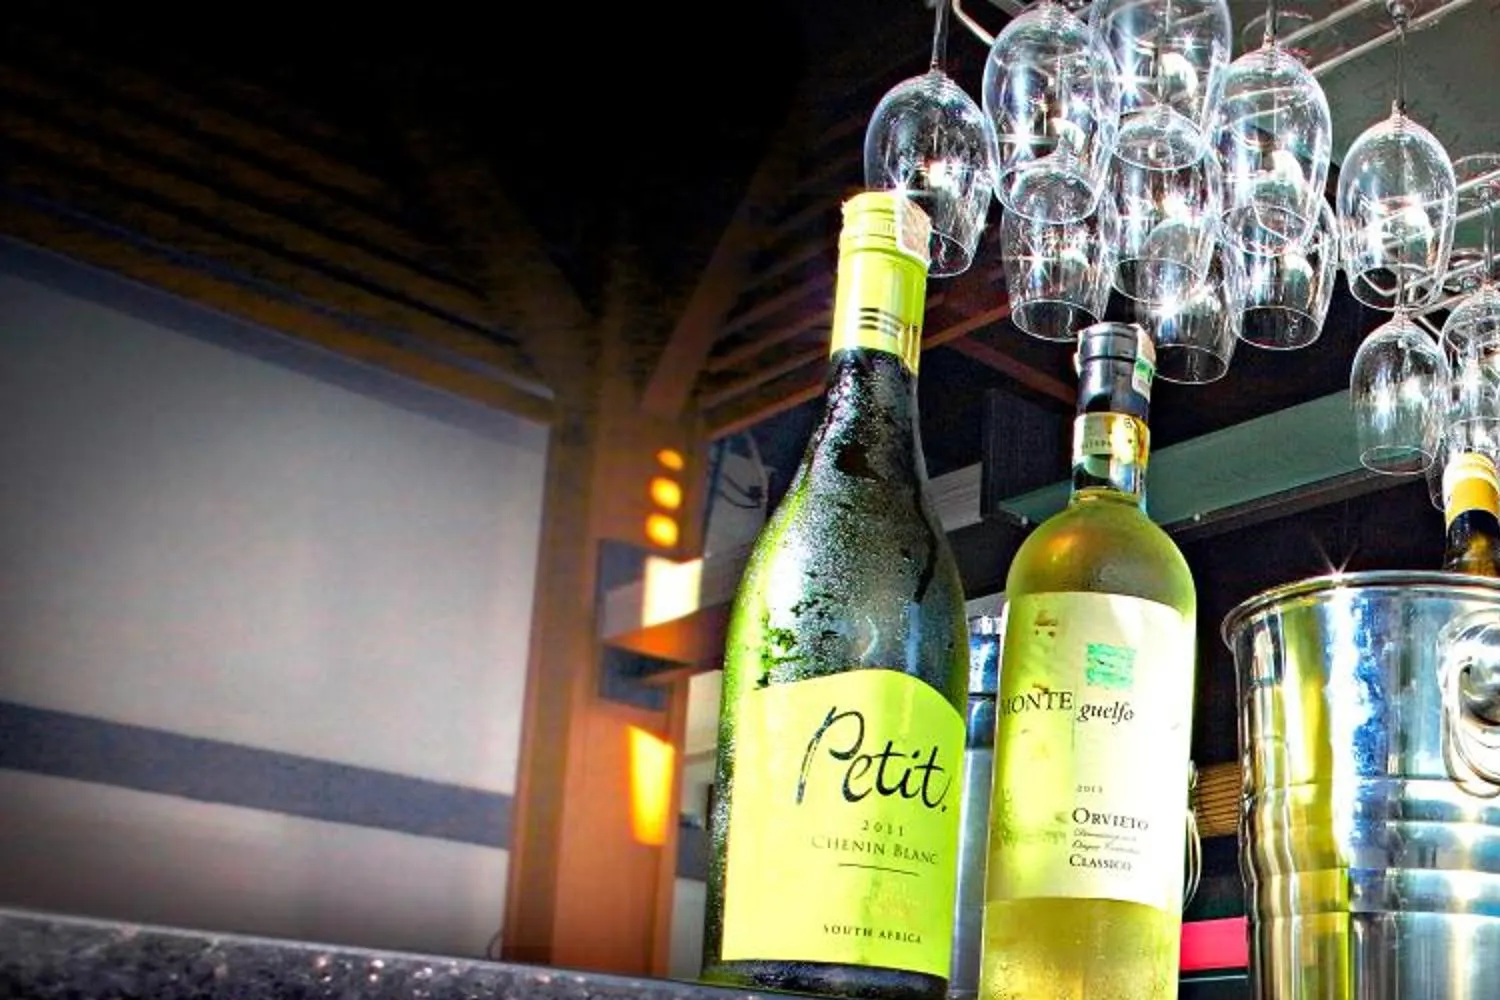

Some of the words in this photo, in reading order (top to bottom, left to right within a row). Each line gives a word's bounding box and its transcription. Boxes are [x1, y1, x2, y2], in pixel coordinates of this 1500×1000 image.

[862, 819, 904, 837] 2011
[811, 836, 886, 856] CHENIN
[893, 843, 939, 865] BLANC
